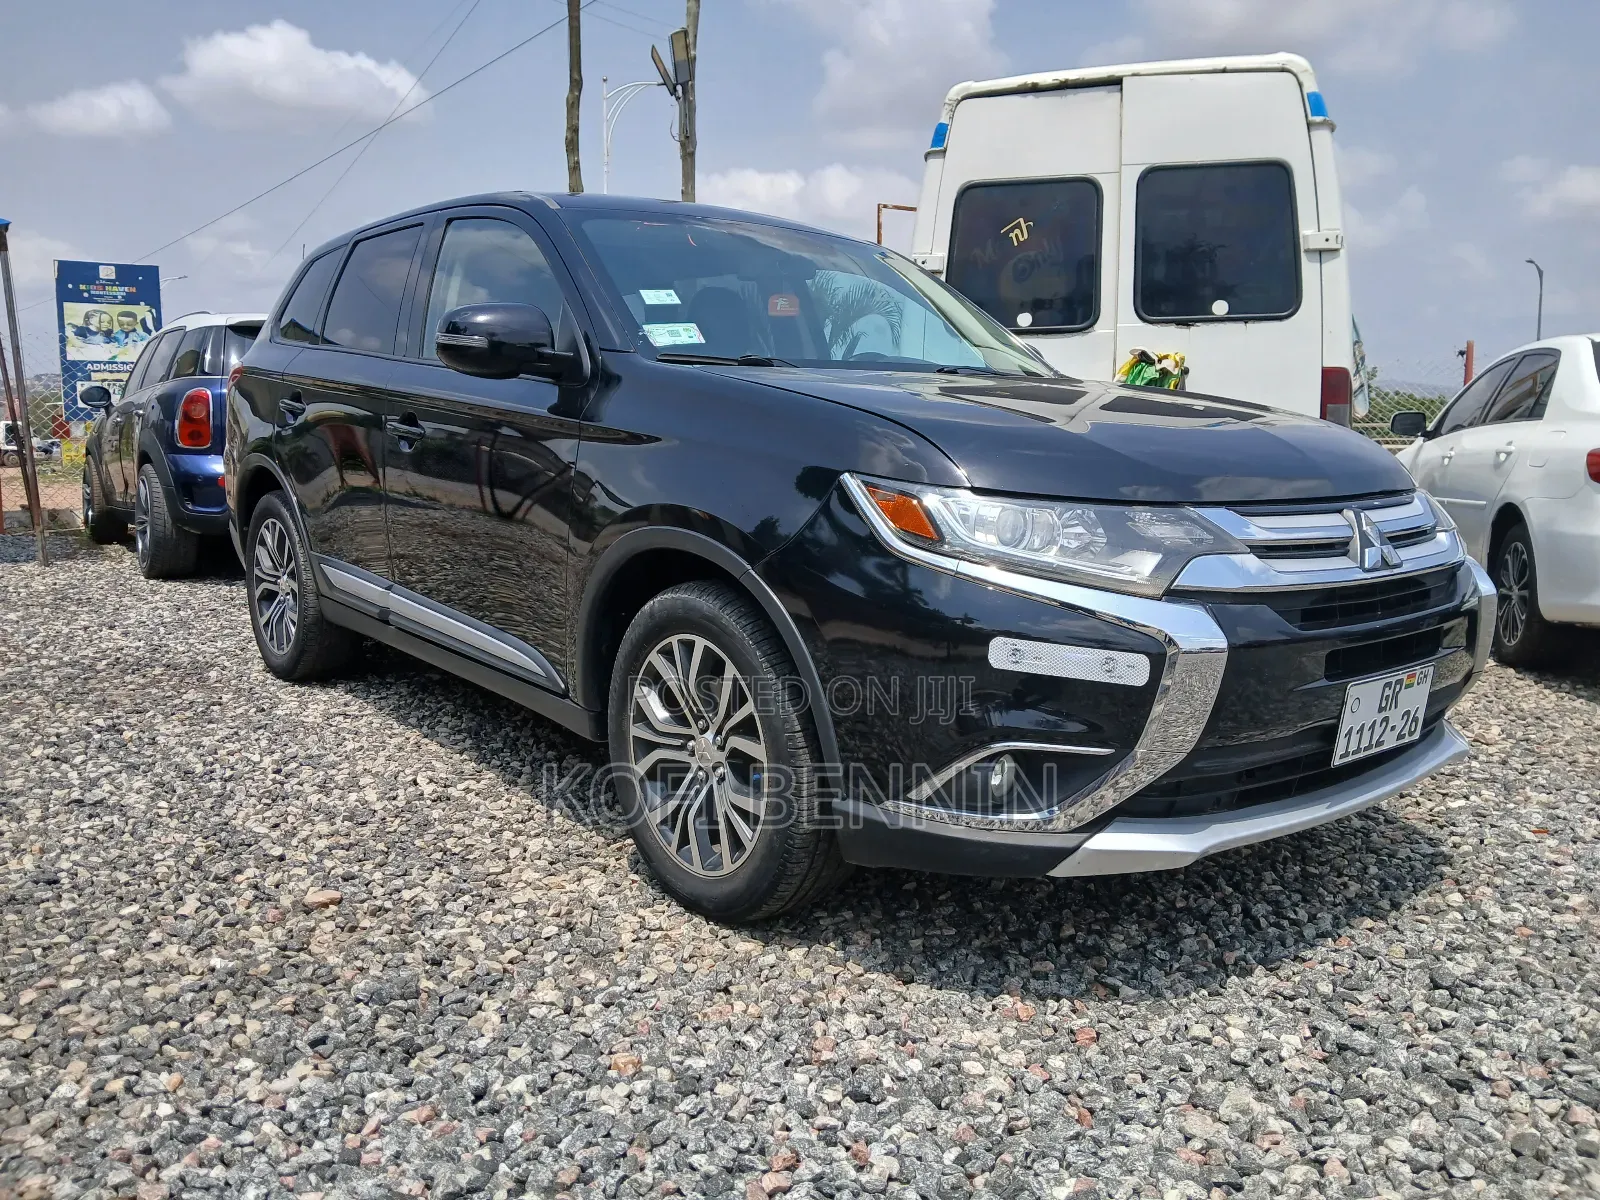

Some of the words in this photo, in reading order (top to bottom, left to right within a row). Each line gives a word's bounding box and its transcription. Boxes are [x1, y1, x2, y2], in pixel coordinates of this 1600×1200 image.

[1378, 678, 1405, 713] GR
[1416, 668, 1430, 686] GH
[1339, 705, 1420, 760] 1112-26
